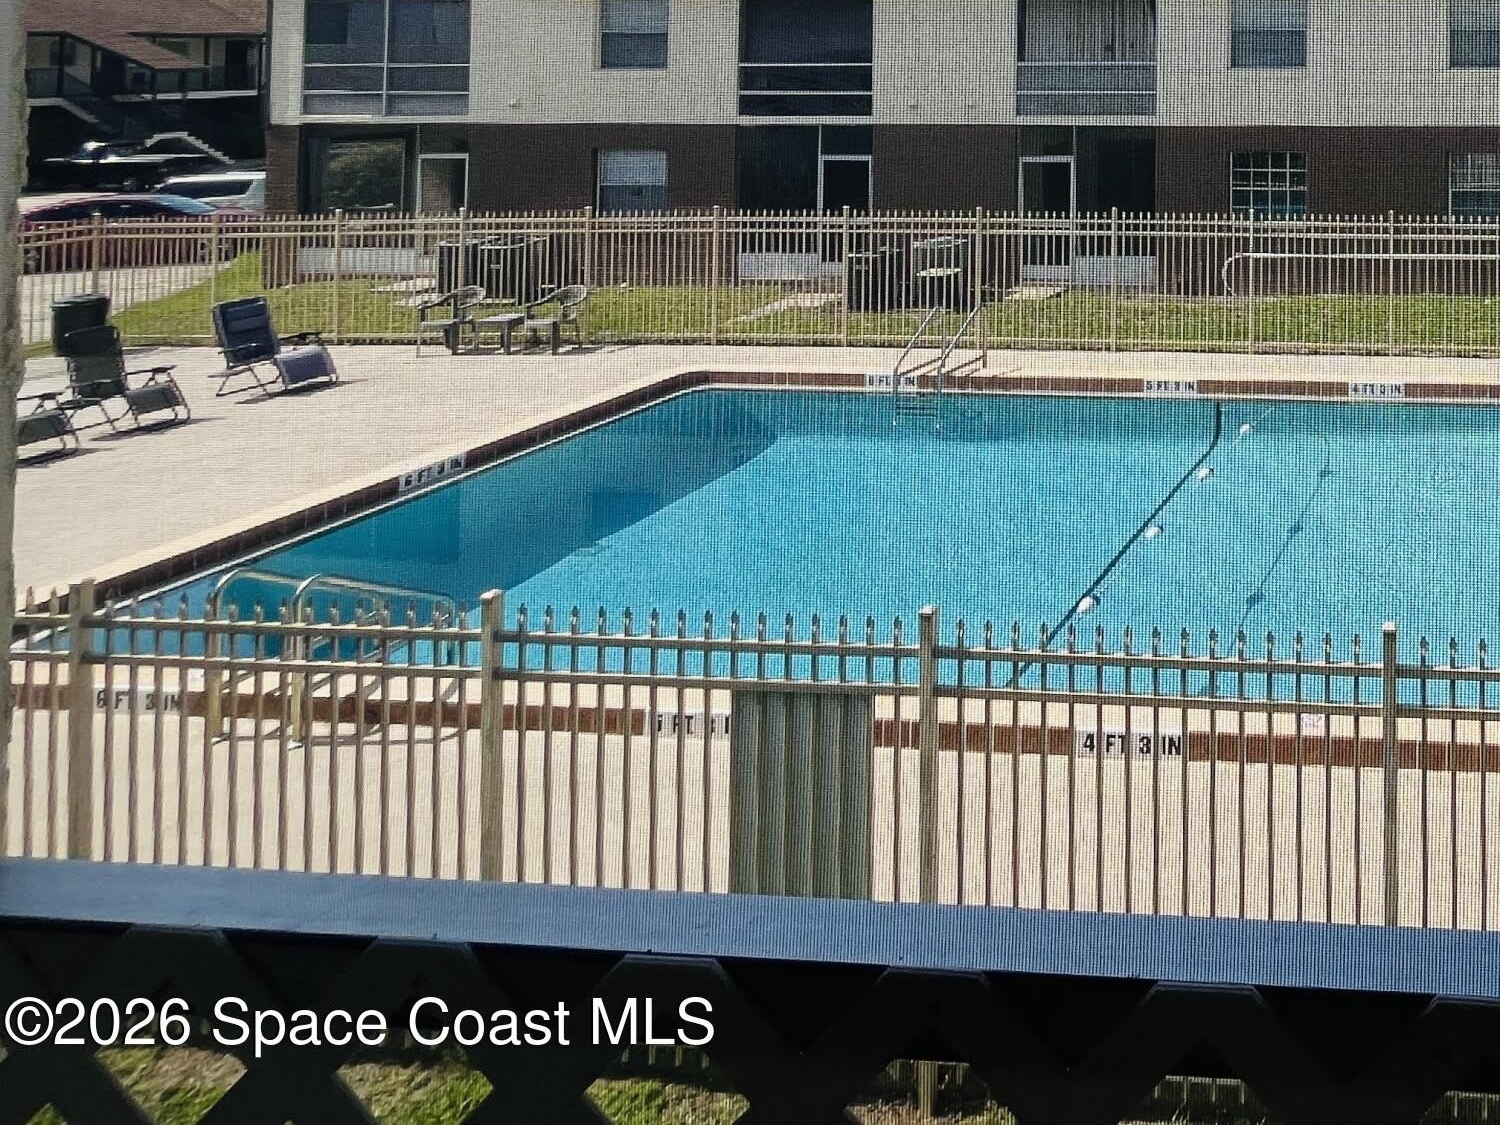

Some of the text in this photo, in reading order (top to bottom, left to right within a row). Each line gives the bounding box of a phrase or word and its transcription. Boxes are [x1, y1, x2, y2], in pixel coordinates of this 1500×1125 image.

[1184, 381, 1195, 392] IN
[1083, 733, 1095, 752] 4
[1139, 735, 1151, 755] 3
[1162, 735, 1181, 756] IN
